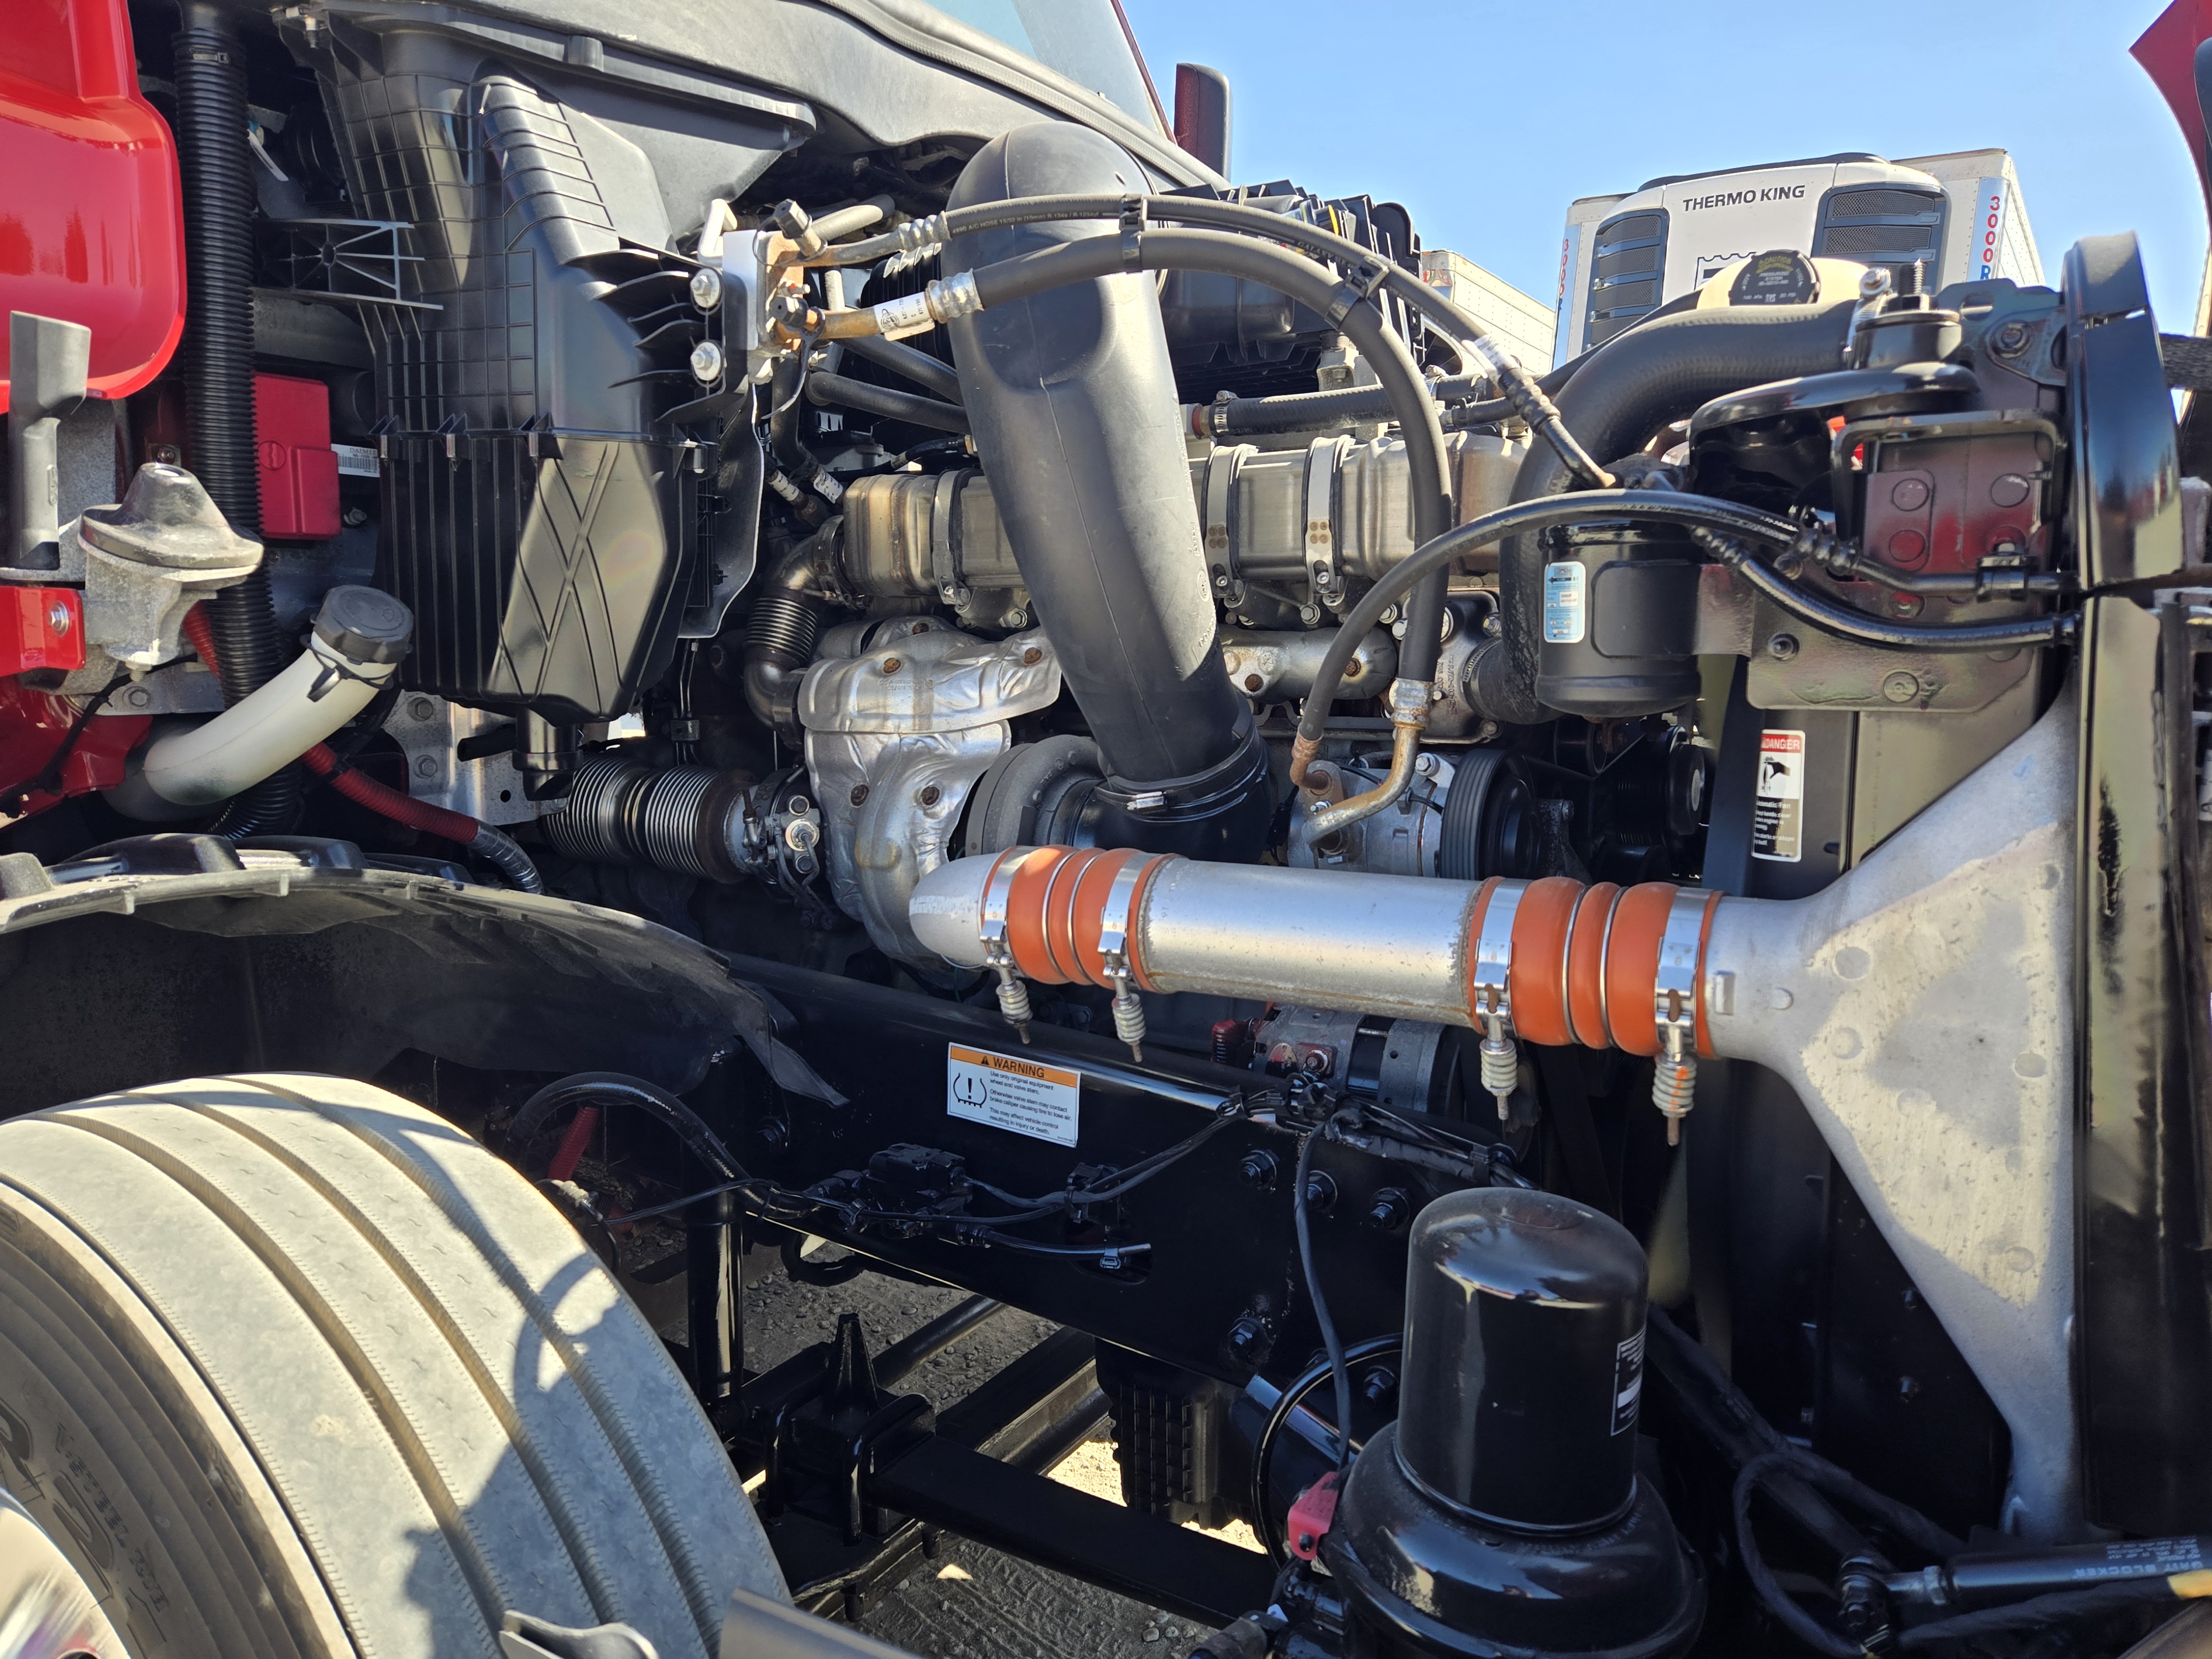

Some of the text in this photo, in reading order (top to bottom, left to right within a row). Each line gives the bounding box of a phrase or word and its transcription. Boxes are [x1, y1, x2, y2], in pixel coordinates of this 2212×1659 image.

[1683, 185, 1805, 211] THERMO KING
[1766, 739, 1800, 750] DANGER
[993, 1057, 1045, 1078] WARNING
[1011, 1075, 1029, 1085] original
[1029, 1079, 1054, 1091] equipment
[990, 1088, 1013, 1099] Otherwise
[1050, 1103, 1067, 1113] contact
[1003, 1099, 1019, 1108] caliper
[1020, 1103, 1037, 1113] causing
[990, 1115, 1010, 1125] resulting
[1015, 1120, 1029, 1130] injury
[1036, 1125, 1050, 1134] death.
[1011, 1112, 1024, 1120] affect
[1025, 1115, 1041, 1125] vehicle
[1042, 1120, 1058, 1129] control
[2075, 1565, 2156, 1577] BLOCKER
